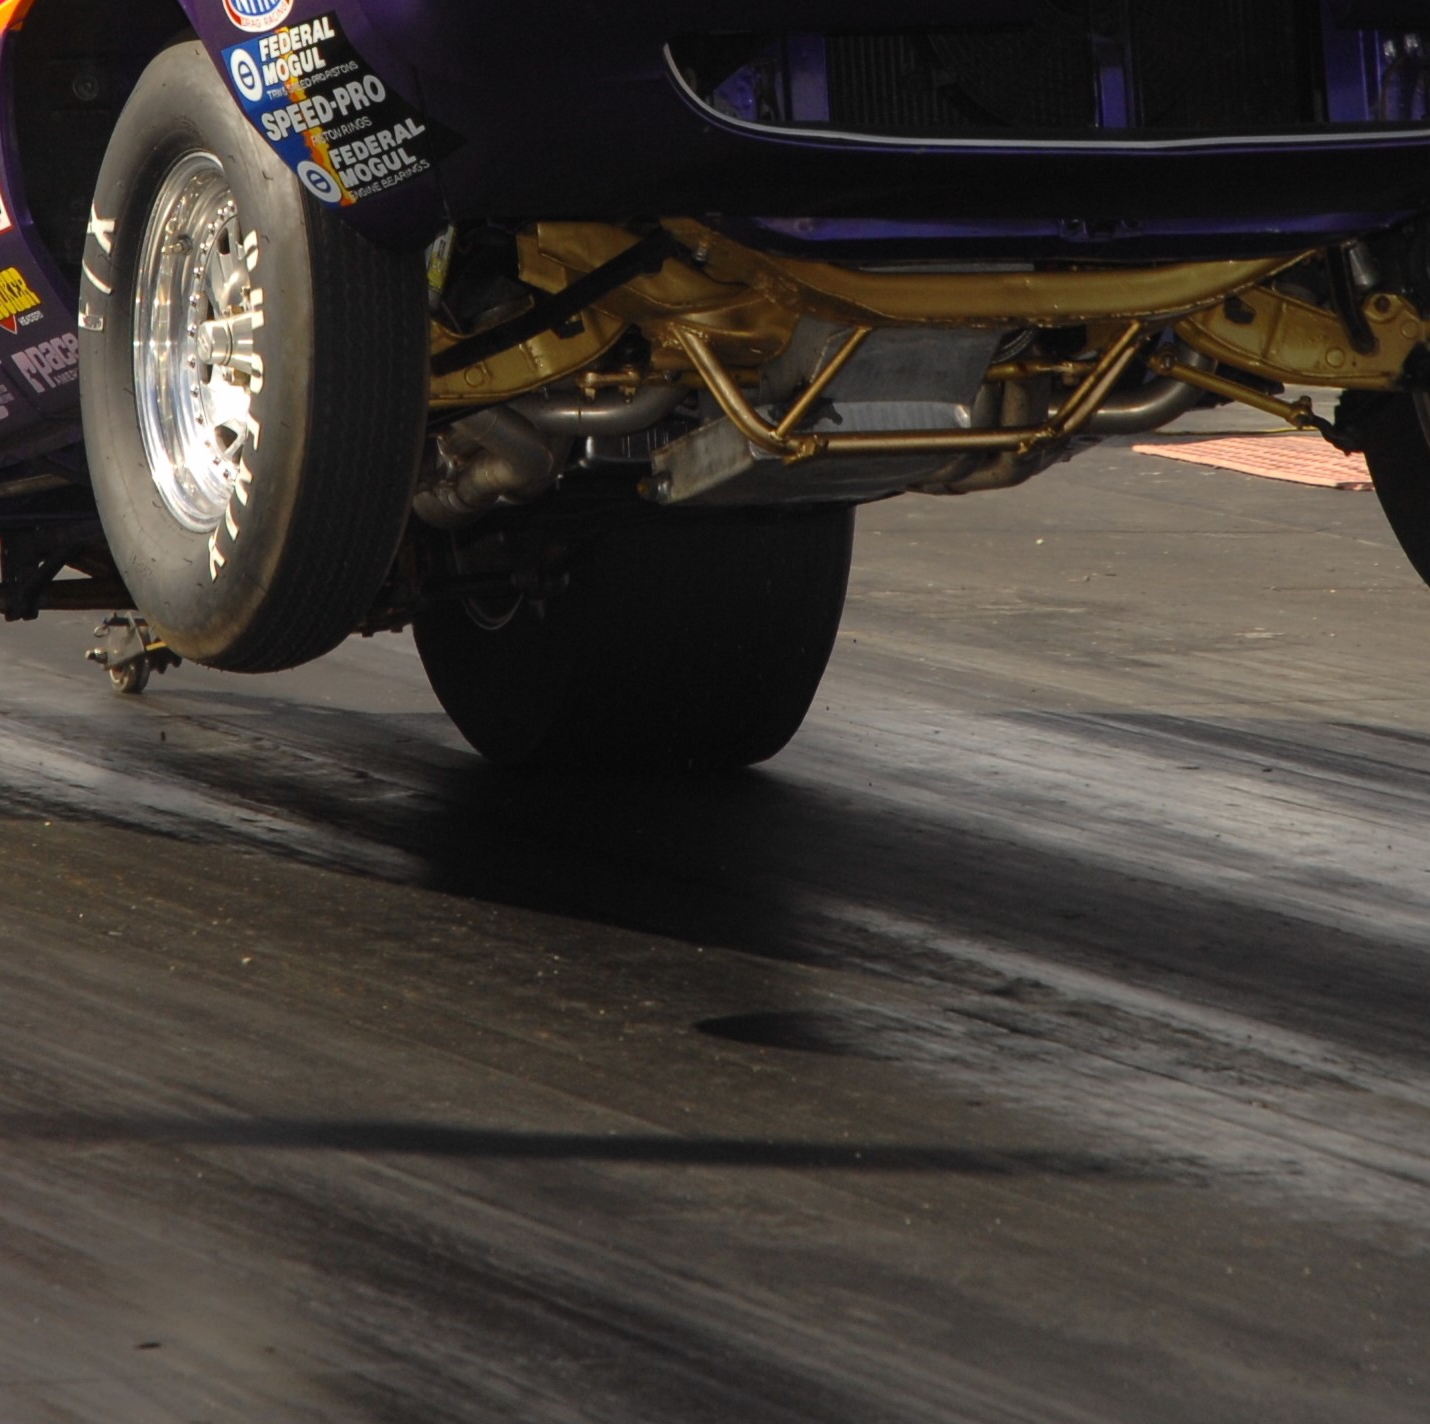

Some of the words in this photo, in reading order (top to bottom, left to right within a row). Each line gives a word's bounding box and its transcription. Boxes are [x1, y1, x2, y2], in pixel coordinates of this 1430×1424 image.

[259, 16, 335, 62] FEDERAL
[262, 47, 326, 86] MOGUL
[261, 74, 386, 141] SPEED-PRO
[341, 116, 372, 135] RINGS
[328, 117, 426, 170] FEDERAL
[338, 147, 417, 188] MOGUL
[380, 159, 430, 188] BEARINGS
